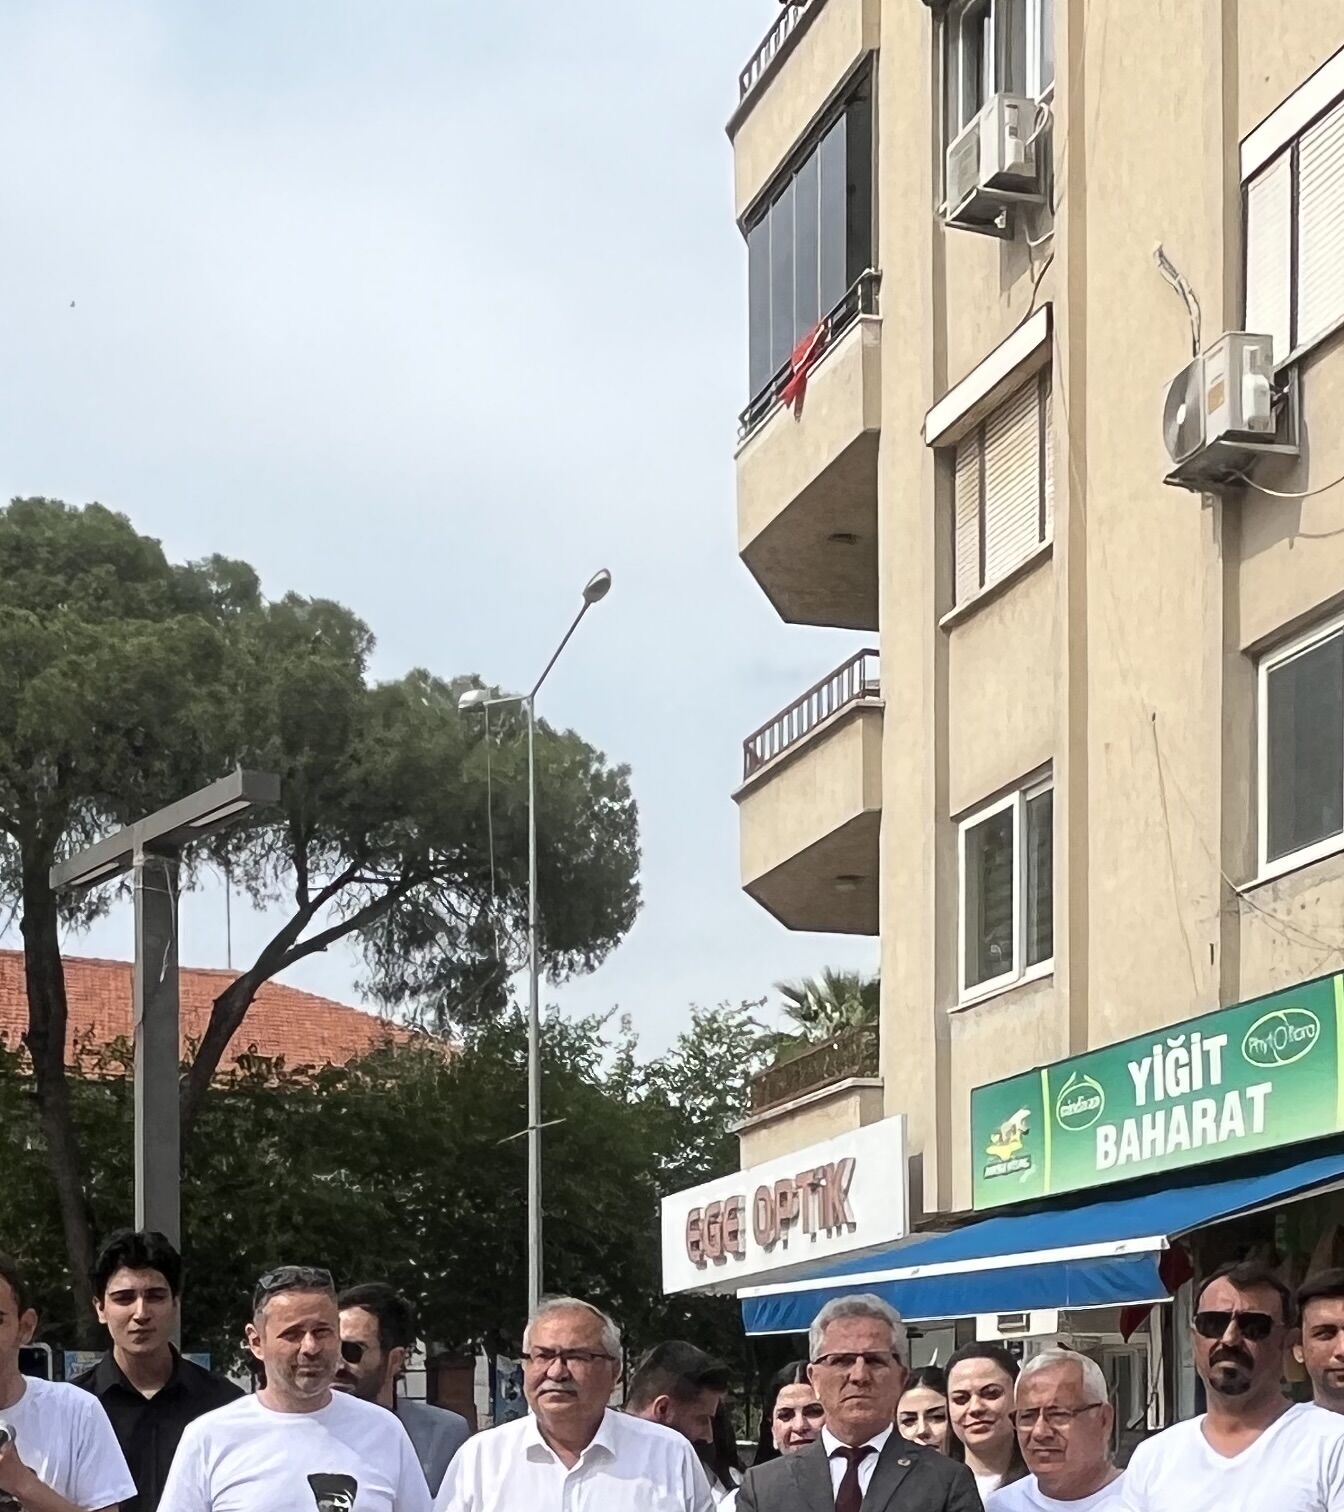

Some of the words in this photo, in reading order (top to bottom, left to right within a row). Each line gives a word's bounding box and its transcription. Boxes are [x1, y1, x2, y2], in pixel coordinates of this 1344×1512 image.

[1127, 1032, 1228, 1107] YİĞİT
[1096, 1081, 1273, 1171] BAHARAT
[686, 1195, 746, 1269] EGE
